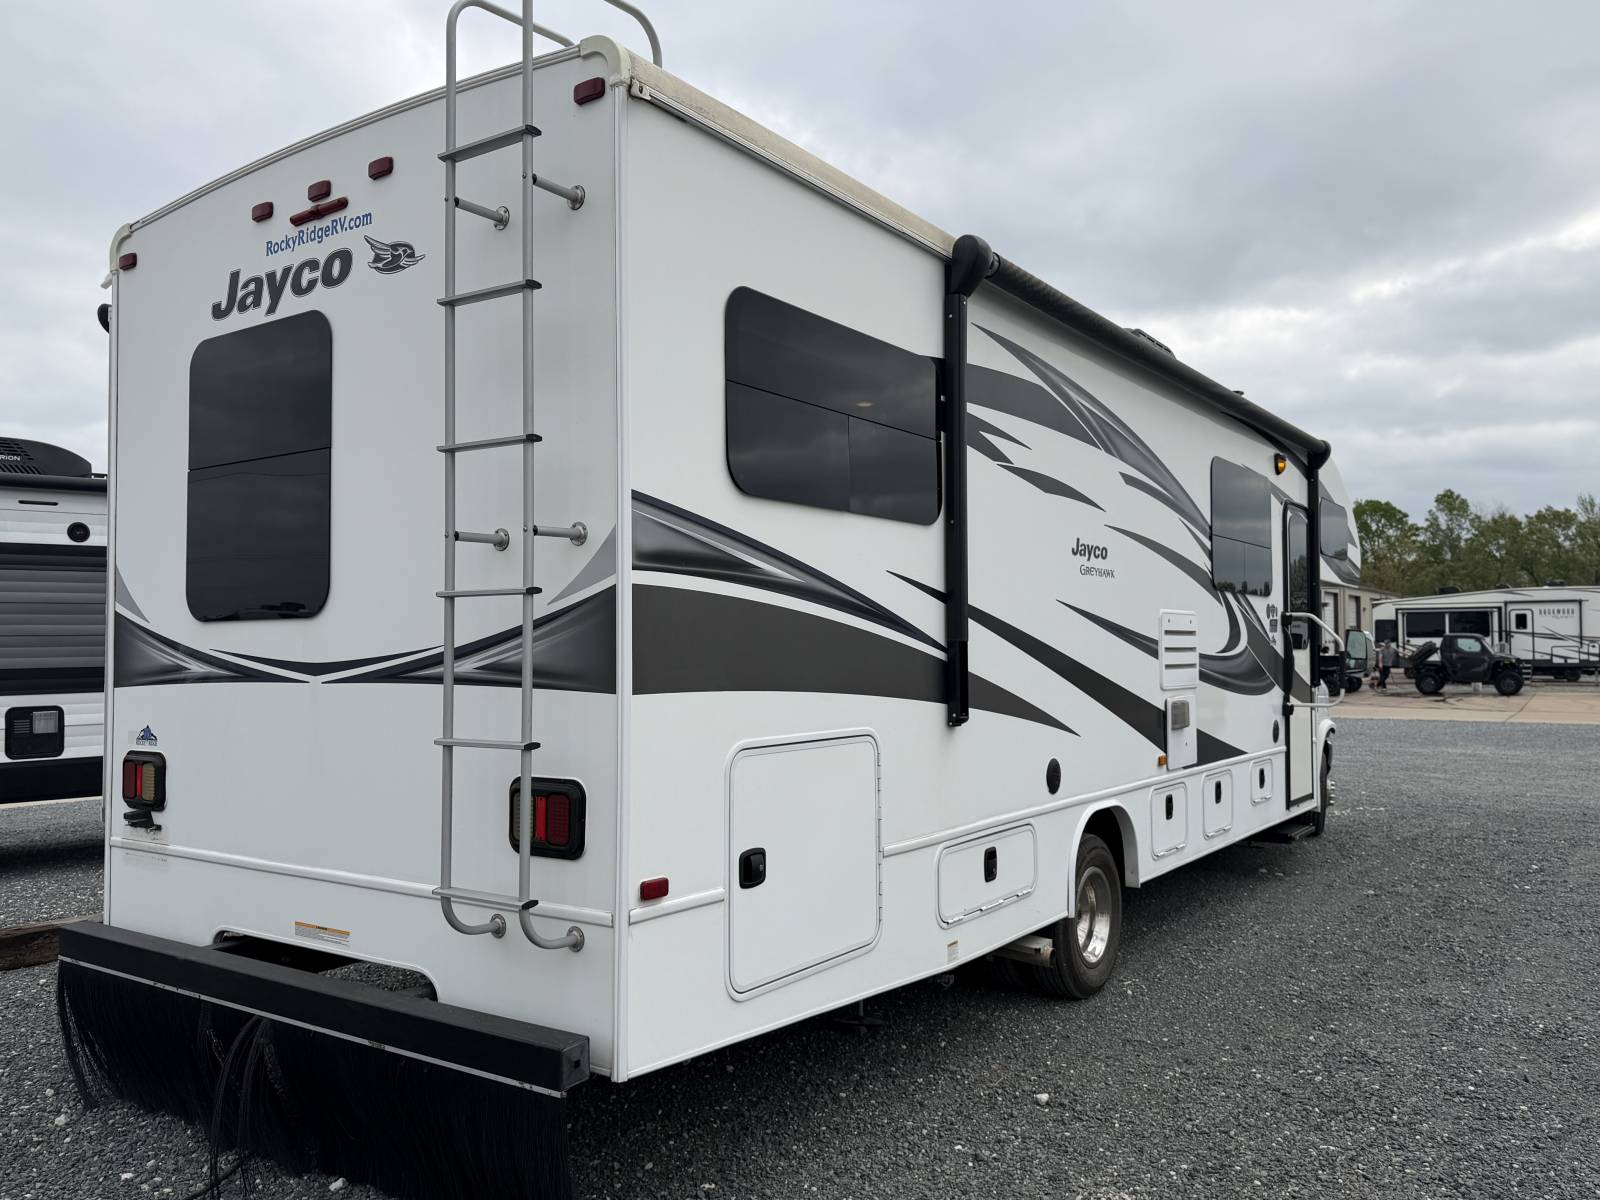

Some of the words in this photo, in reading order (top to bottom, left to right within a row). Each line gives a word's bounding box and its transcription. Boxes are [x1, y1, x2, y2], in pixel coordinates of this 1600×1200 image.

[265, 211, 373, 257] RockyRidgeRV.com
[211, 247, 353, 321] Jayco
[1071, 537, 1108, 561] Jayco
